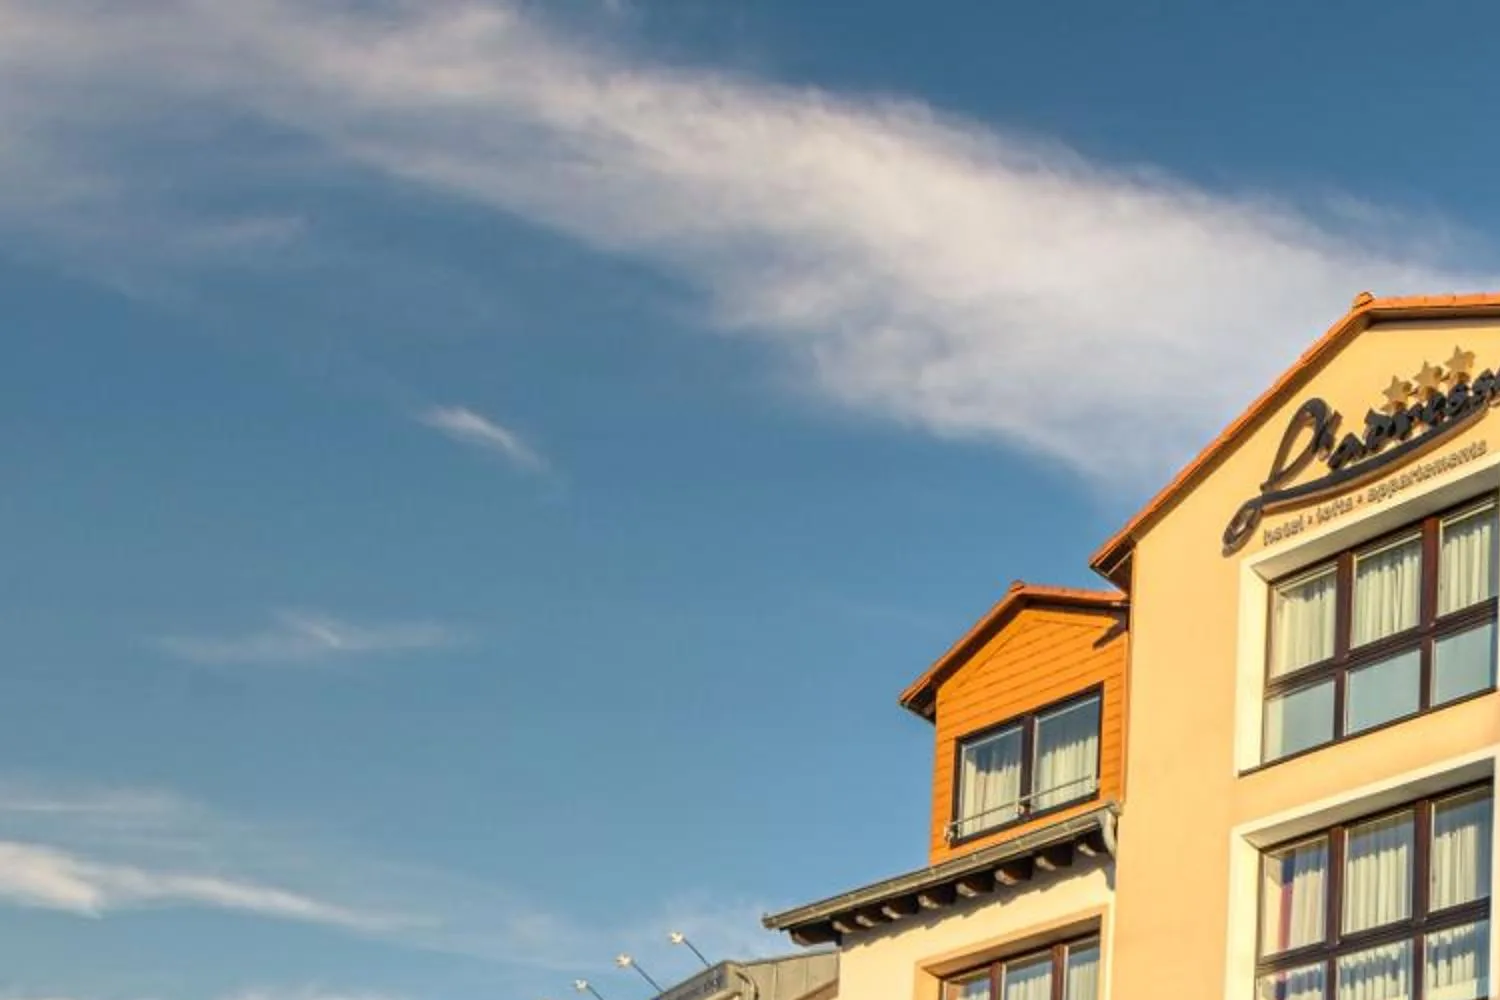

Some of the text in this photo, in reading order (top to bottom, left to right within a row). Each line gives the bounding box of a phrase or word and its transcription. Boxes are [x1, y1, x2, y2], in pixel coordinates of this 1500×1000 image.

[1263, 440, 1488, 547] hotel lofts appartements
